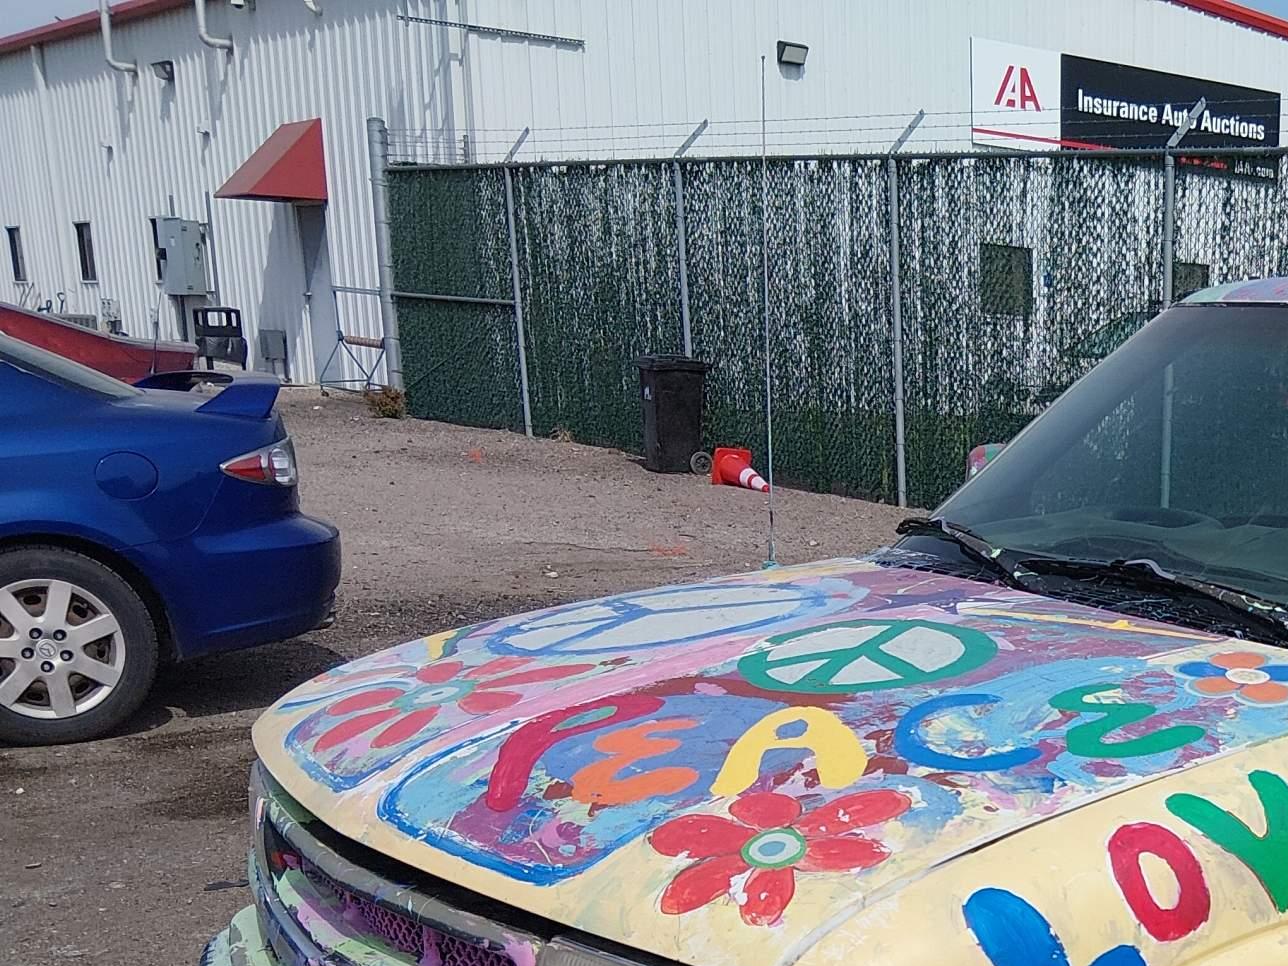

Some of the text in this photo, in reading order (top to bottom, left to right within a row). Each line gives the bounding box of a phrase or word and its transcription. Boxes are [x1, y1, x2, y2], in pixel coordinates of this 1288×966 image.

[1077, 87, 1159, 124] Insurance
[1199, 109, 1266, 141] Auctions
[486, 682, 1206, 812] PEACE
